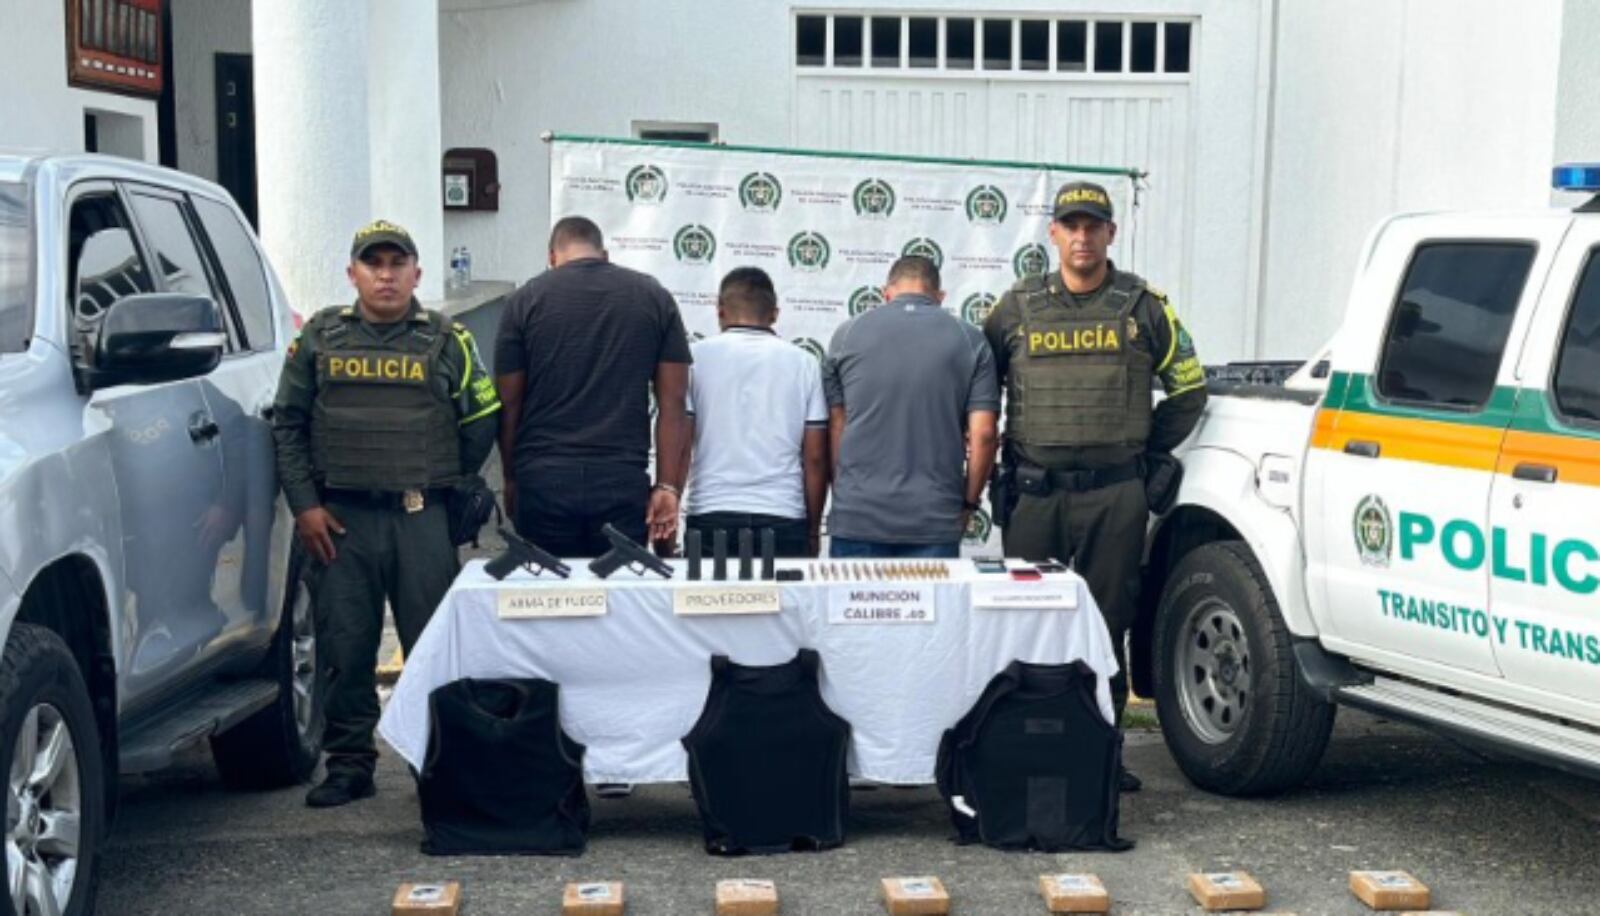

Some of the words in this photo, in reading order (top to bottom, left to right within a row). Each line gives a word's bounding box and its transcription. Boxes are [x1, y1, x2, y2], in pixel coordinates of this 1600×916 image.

[1029, 324, 1119, 352] POLICÍA
[329, 355, 425, 381] POLICÍA
[843, 607, 901, 619] CALIBRE
[1377, 589, 1488, 638] TRANSITO
[1492, 615, 1509, 644] Y
